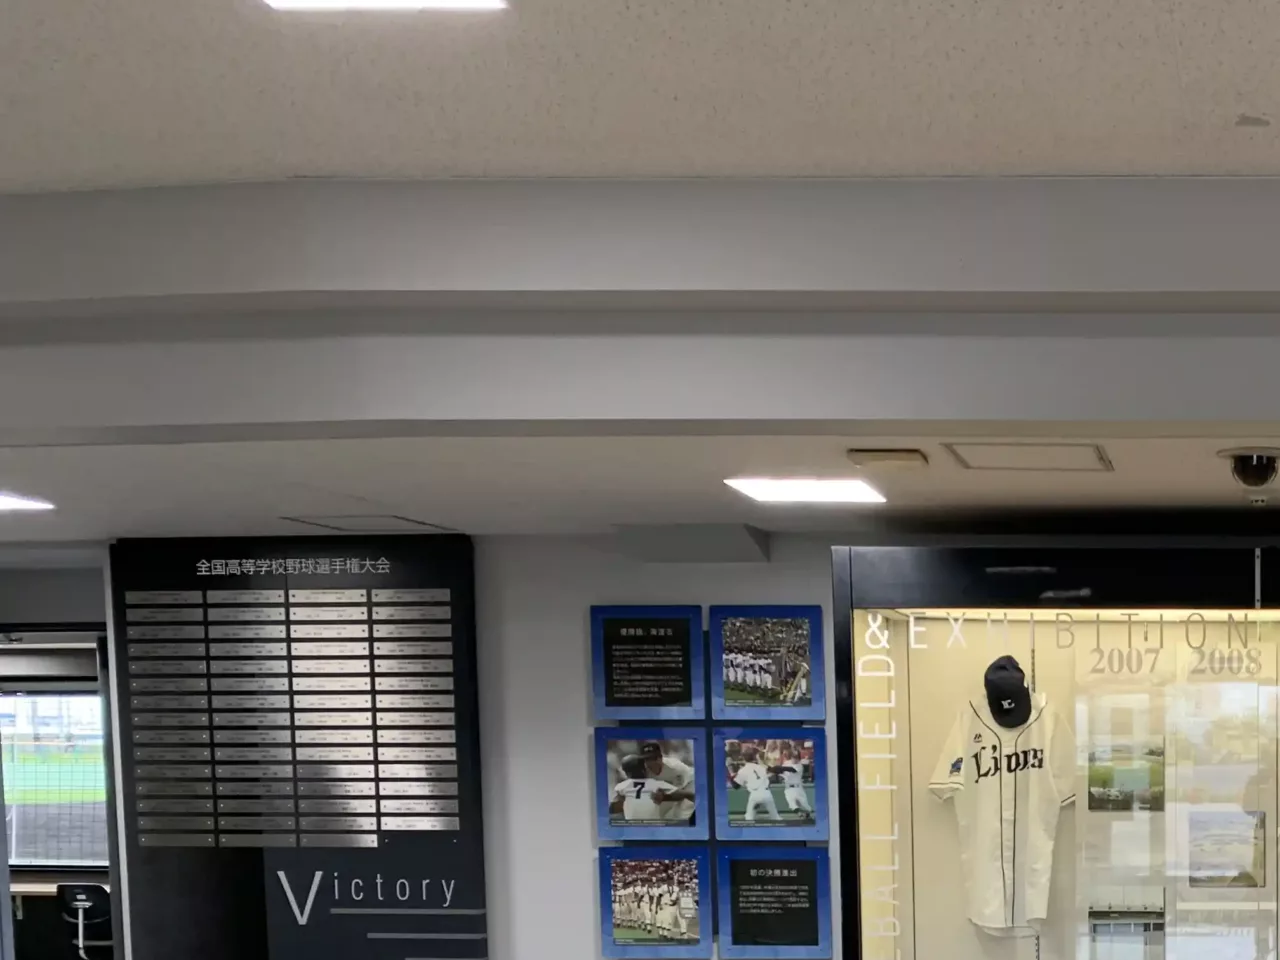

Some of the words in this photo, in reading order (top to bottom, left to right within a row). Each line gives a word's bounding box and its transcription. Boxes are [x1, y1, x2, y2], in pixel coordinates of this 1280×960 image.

[195, 556, 391, 576] 全国高等学校野球選手権大会
[864, 612, 890, 649] &
[908, 611, 1250, 650] EXHIBITION
[1089, 647, 1161, 675] 2007
[1189, 647, 1263, 676] 2008
[857, 654, 899, 791] FIELD
[970, 743, 1044, 784] Lions
[632, 781, 646, 800] 7
[276, 870, 455, 925] Victory
